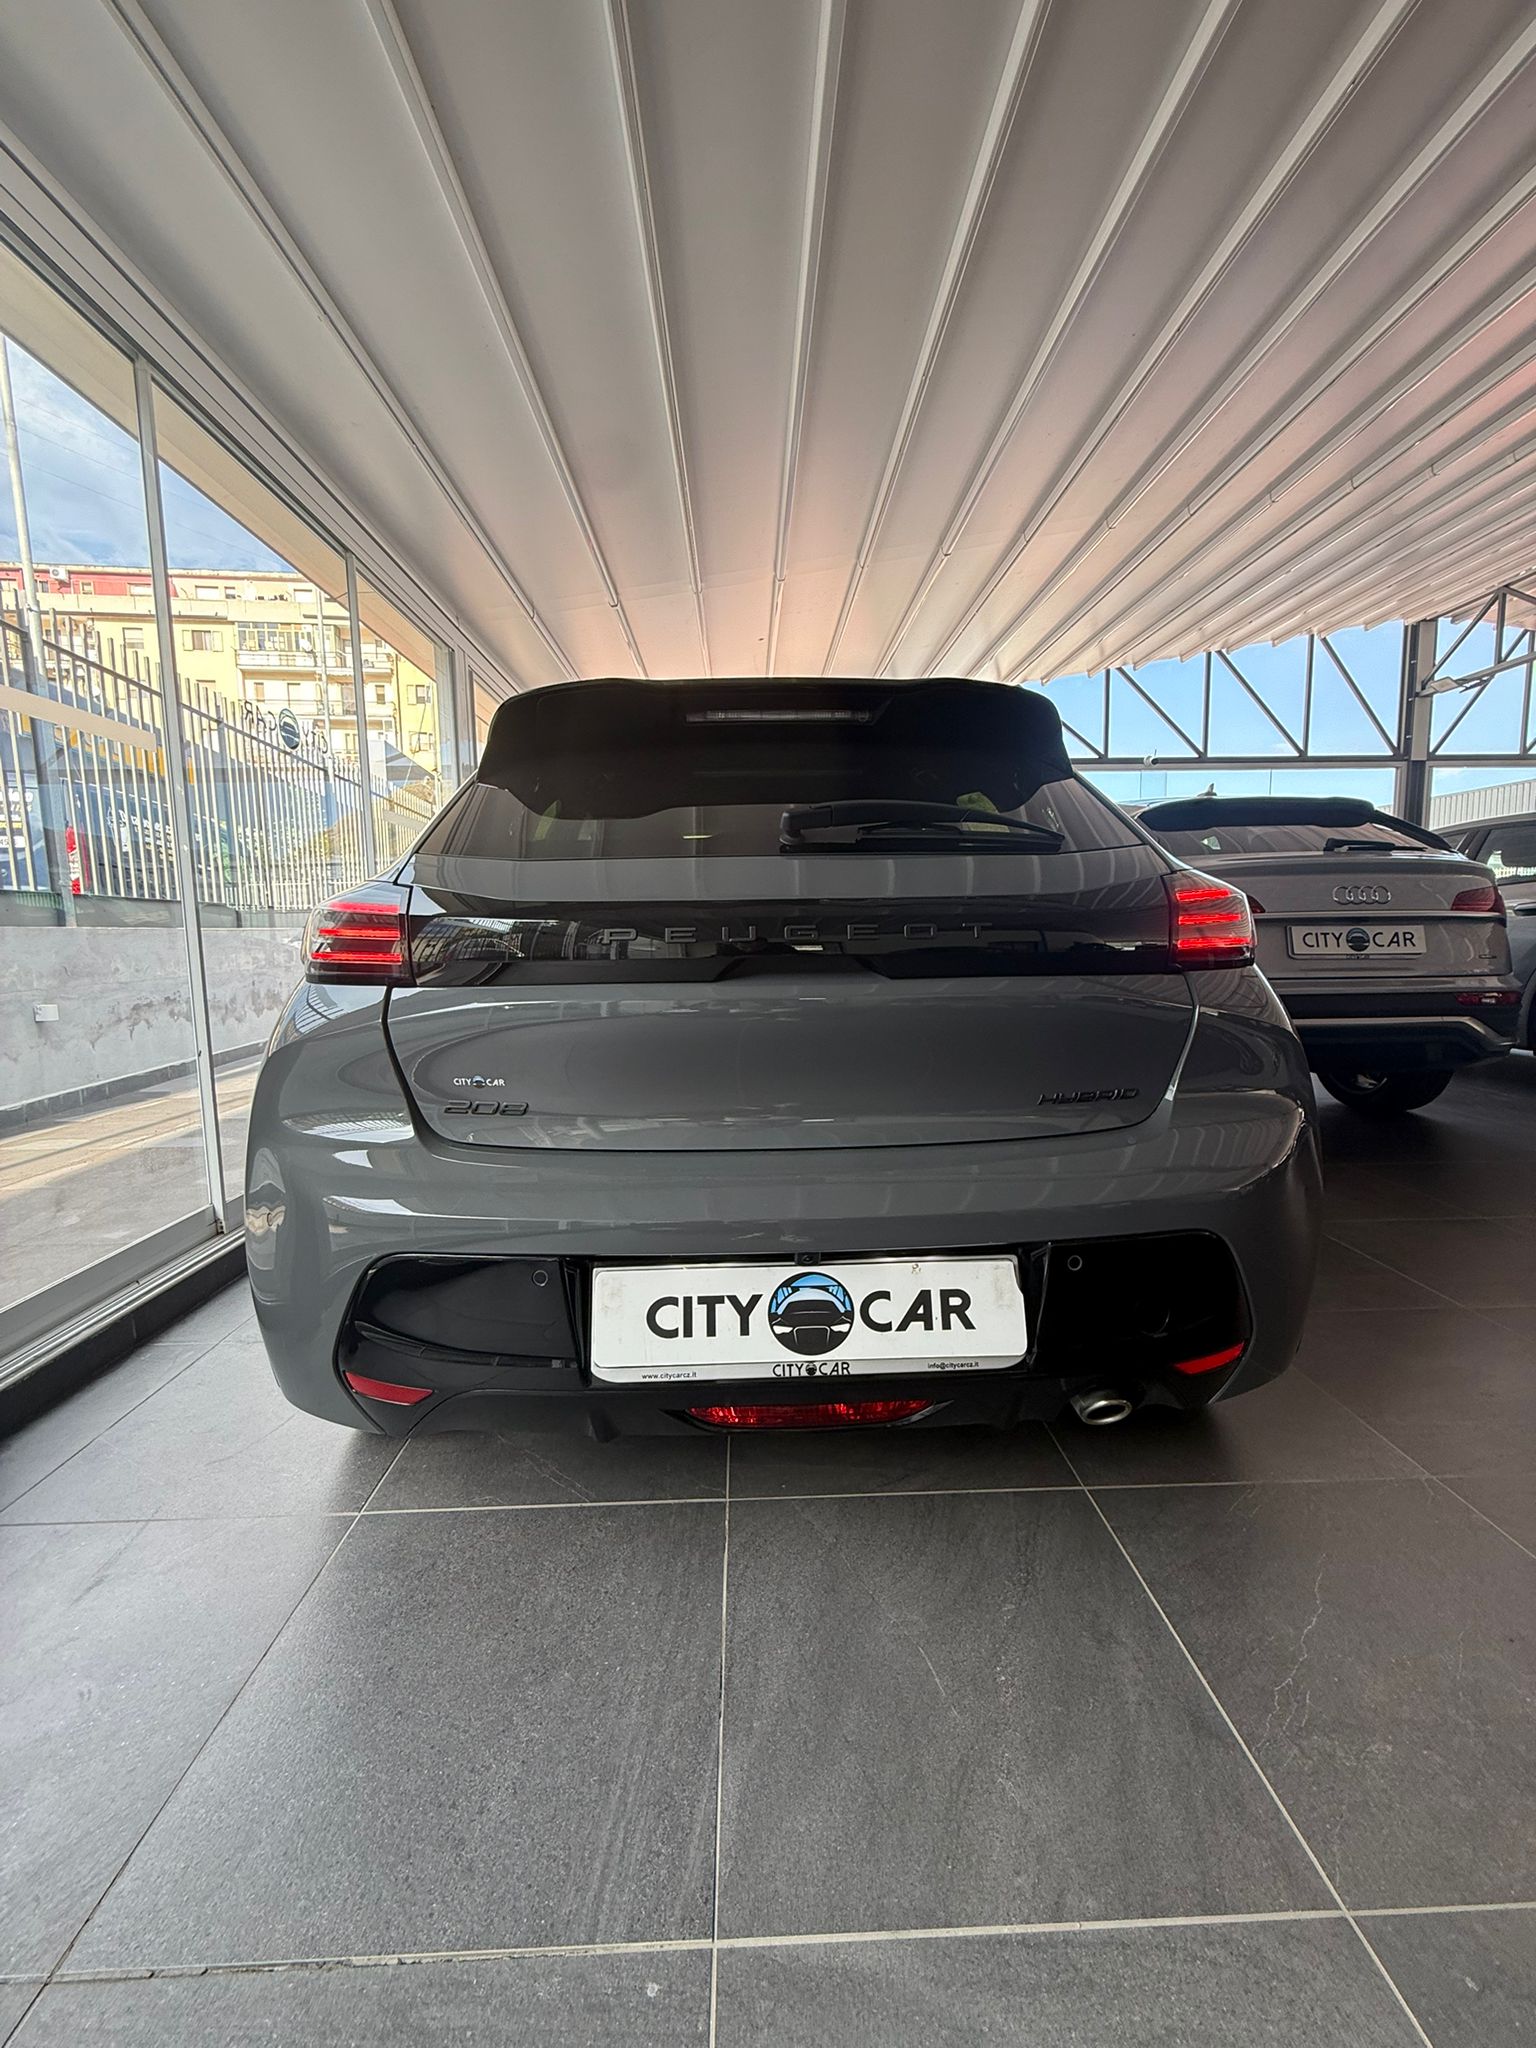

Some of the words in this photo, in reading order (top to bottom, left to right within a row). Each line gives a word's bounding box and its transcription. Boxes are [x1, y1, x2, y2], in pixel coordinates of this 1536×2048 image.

[602, 921, 992, 944] PEUGEOT
[1302, 931, 1343, 948] CITY
[1372, 931, 1416, 948] CAR
[453, 1077, 472, 1086] CITY
[486, 1078, 506, 1087] CAR
[1037, 1088, 1139, 1105] HYBRID
[444, 1100, 529, 1116] 208
[646, 1293, 764, 1339] CITY
[859, 1288, 976, 1334] CAR
[772, 1362, 804, 1377] CITY
[818, 1361, 851, 1376] CAR
